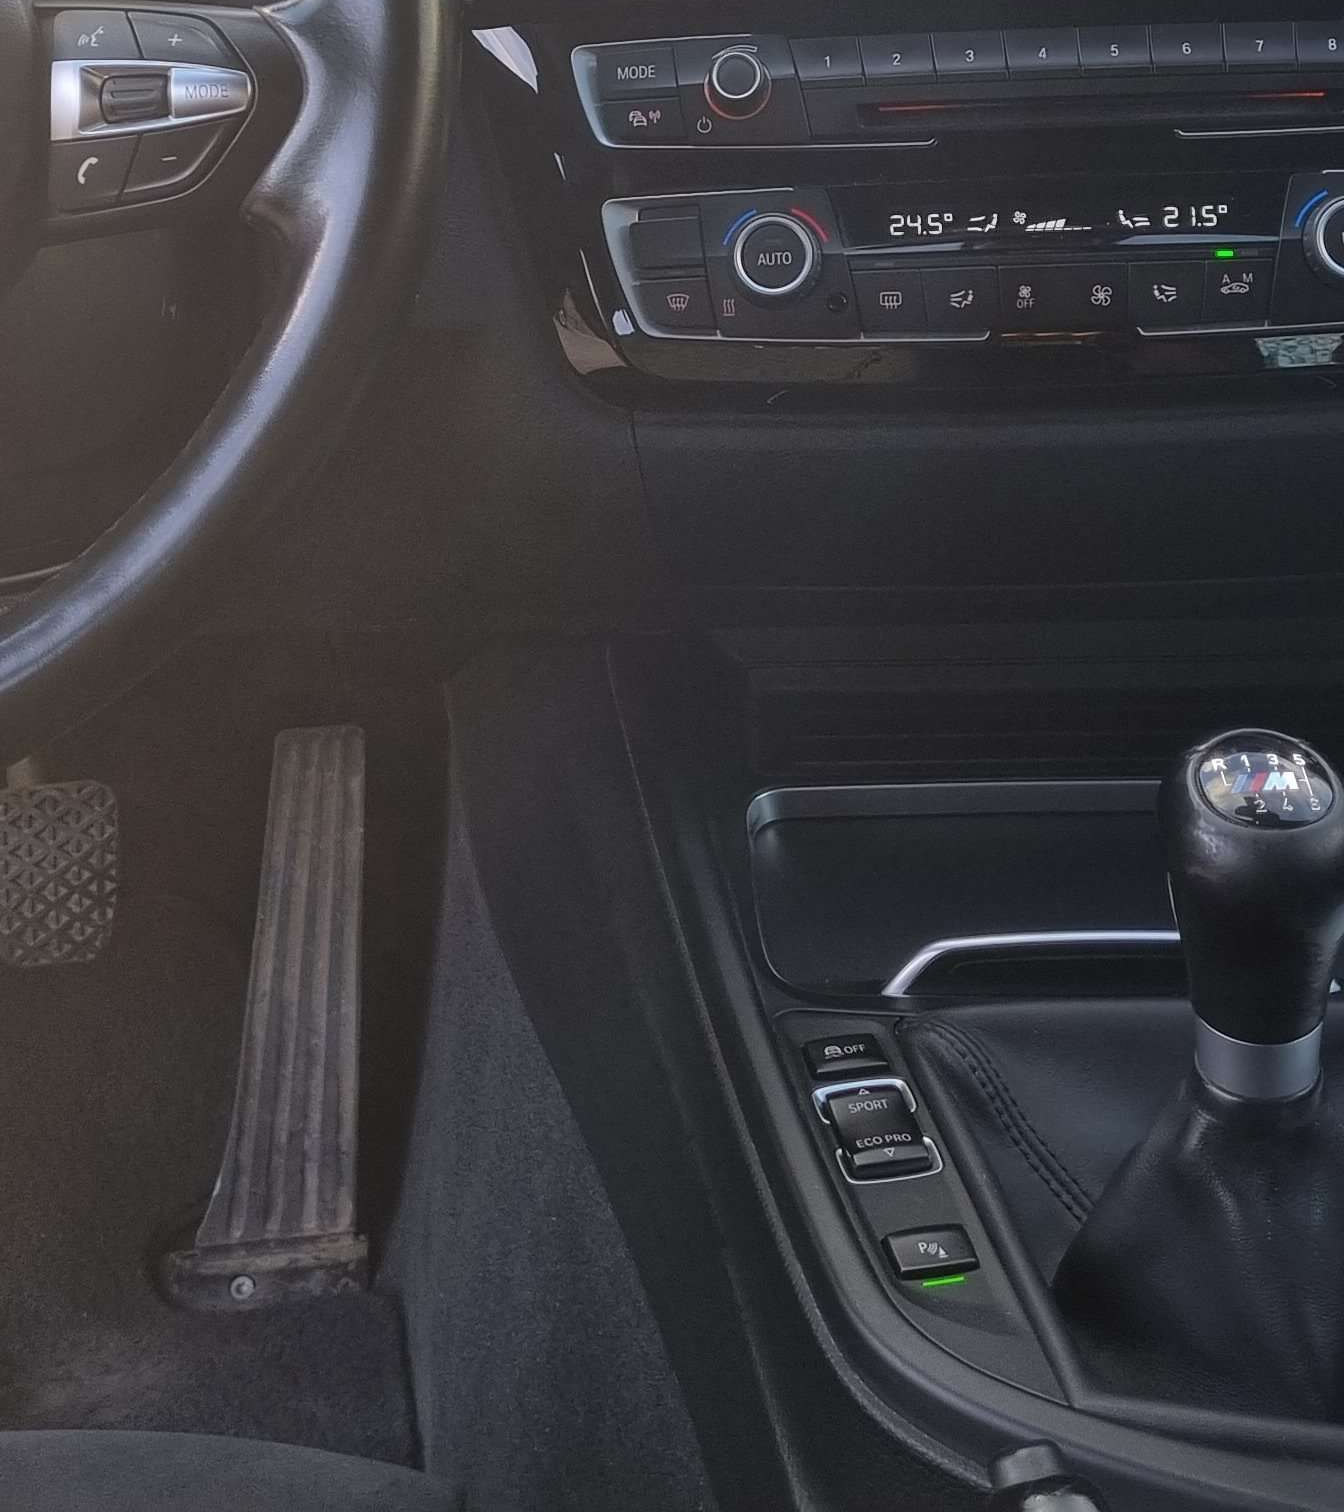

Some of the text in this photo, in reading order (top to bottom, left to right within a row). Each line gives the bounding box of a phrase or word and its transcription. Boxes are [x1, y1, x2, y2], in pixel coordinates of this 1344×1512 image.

[824, 39, 1337, 68] 1 2 3 4 5 6 7 8
[617, 65, 656, 80] MODE
[185, 84, 229, 98] MODE
[757, 251, 792, 265] AUTO
[1222, 273, 1253, 284] A M
[1017, 298, 1035, 309] OFF
[1211, 754, 1306, 771] R 1 3 5
[1255, 772, 1299, 790] M
[843, 1044, 865, 1055] OFF
[848, 1099, 889, 1114] SPORT
[856, 1133, 912, 1149] ECO PRO
